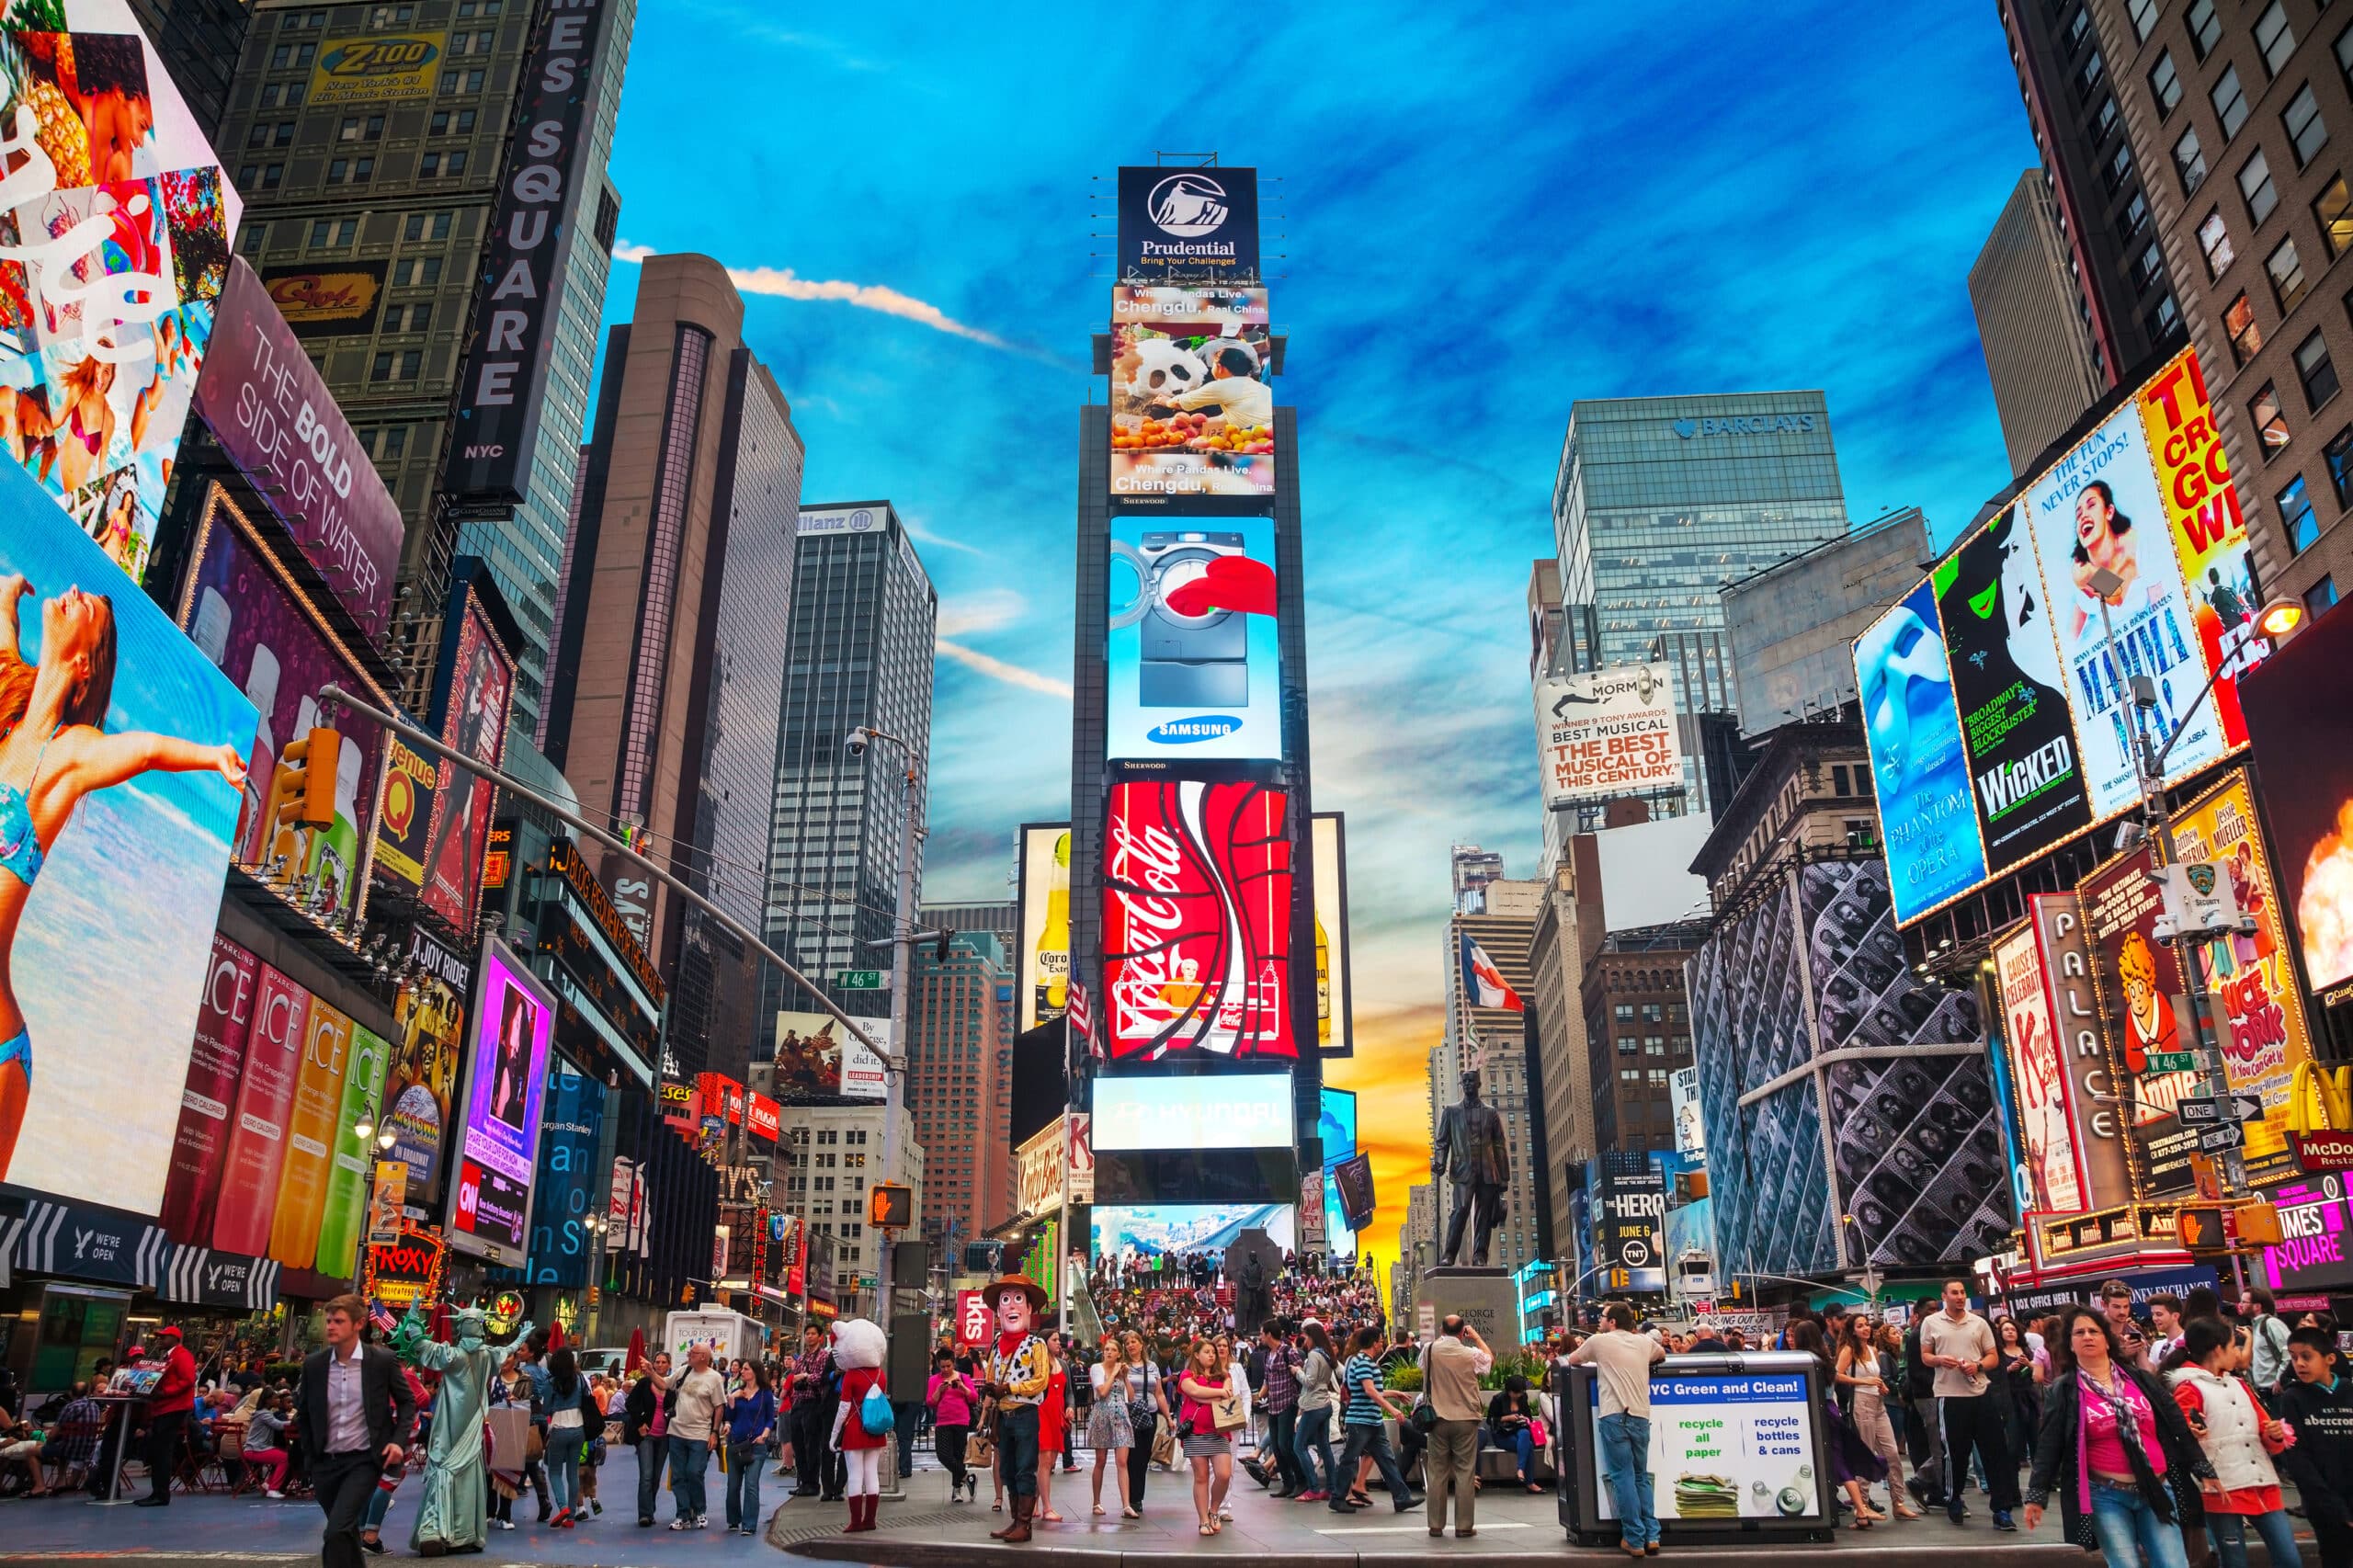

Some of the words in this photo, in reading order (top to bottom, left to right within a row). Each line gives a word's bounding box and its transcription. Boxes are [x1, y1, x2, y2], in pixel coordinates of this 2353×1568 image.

[330, 41, 429, 75] Z100
[313, 91, 334, 102] Hit
[337, 90, 378, 99] Music
[381, 87, 428, 97] Station
[324, 81, 358, 91] New
[1142, 241, 1235, 256] Prudential
[475, 120, 562, 405] SQUARE
[1141, 257, 1165, 266] Bring
[1188, 256, 1236, 266] Challenges
[1219, 290, 1245, 298] Live.
[1116, 301, 1202, 317] Chengdu,
[254, 324, 298, 419] THE
[294, 400, 352, 499] BOLD
[1702, 415, 1813, 436] BARCLAYS
[464, 445, 504, 459] NYC
[2054, 453, 2079, 483] THE
[2080, 429, 2106, 461] FUN
[1135, 464, 1176, 474] Where
[1176, 464, 1221, 474] Pandas
[1224, 464, 1252, 474] Live.
[2041, 474, 2080, 515] NEVER
[2082, 431, 2129, 482] STOPS!
[236, 382, 292, 478] SIDE
[291, 459, 322, 510] OF
[322, 494, 380, 604] WATER
[1116, 476, 1207, 494] Chengdu,
[2075, 607, 2190, 722] MAMMA
[1159, 723, 1232, 736] SAMSUNG
[1552, 719, 1589, 731] WINNER
[1600, 714, 1625, 723] TONY
[1627, 709, 1667, 720] AWARDS
[1971, 706, 2006, 740] BIGGEST
[1552, 729, 1591, 743] BEST
[1597, 719, 1668, 737] MUSICAL
[2188, 728, 2208, 745] ABBA
[1608, 732, 1669, 755] BEST
[1555, 754, 1641, 777] MUSICAL
[1645, 750, 1672, 765] OF
[1556, 775, 1593, 789] THIS
[382, 766, 415, 844] Q
[1913, 790, 1933, 810] The
[1891, 788, 1967, 850] PHANTOM
[2215, 801, 2236, 825] Jessie
[1918, 834, 1927, 855] of
[1929, 829, 1943, 848] the
[2213, 815, 2248, 851] MUELLER
[1908, 844, 1959, 884] OPERA
[2112, 868, 2143, 894] ULTIMATE
[2093, 892, 2126, 919] FEEL-GOOD
[2105, 913, 2112, 923] IS
[2113, 903, 2130, 918] BACK
[2131, 892, 2144, 906] AND
[2098, 923, 2120, 940] BETTER
[2120, 911, 2138, 926] THAN
[214, 935, 255, 967] SPARKLING
[420, 943, 442, 972] JOY
[442, 952, 470, 993] RIDE!
[2007, 951, 2030, 982] CAUSE
[202, 951, 251, 1025] ICE
[267, 971, 304, 1000] SPARKLING
[851, 973, 864, 987] 46
[868, 972, 877, 981] ST
[2221, 968, 2269, 1019] NICE
[258, 985, 301, 1052] ICE
[862, 1022, 874, 1033] By
[2055, 913, 2115, 1139] PALACE
[210, 1037, 242, 1060] Raspberry
[308, 1015, 346, 1076] ICE
[350, 1041, 381, 1098] ICE
[853, 1055, 869, 1065] did
[870, 1054, 881, 1065] it.
[2149, 1056, 2159, 1071] W
[2164, 1056, 2177, 1070] 46
[2180, 1054, 2188, 1062] ST
[2231, 1064, 2236, 1080] If
[2237, 1062, 2251, 1079] You
[2251, 1059, 2264, 1076] Can
[2263, 1053, 2277, 1070] Get
[848, 1072, 882, 1081] LEADERSHIP
[183, 1094, 198, 1105] ZERO
[198, 1097, 224, 1116] CALORIES
[2134, 1071, 2199, 1126] Annie
[1157, 1102, 1278, 1119] HYUNDAI
[2187, 1106, 2211, 1117] ONE
[244, 1117, 256, 1128] ZERO
[256, 1122, 279, 1137] CALORIES
[392, 1109, 439, 1140] MOTOWN
[565, 1122, 591, 1136] Stanley
[2206, 1135, 2218, 1147] ONE
[2224, 1130, 2237, 1141] WAY
[2303, 1141, 2353, 1155] McDo
[403, 1147, 430, 1168] BROADWAY
[1018, 1151, 1042, 1215] Kinky
[1041, 1141, 1064, 1199] Boots
[460, 1181, 478, 1215] CNN
[1606, 1199, 1616, 1208] THE
[1616, 1193, 1665, 1218] HERO
[1619, 1225, 1643, 1238] JUNE
[1643, 1225, 1651, 1237] 6
[2080, 1225, 2101, 1243] Annie
[2111, 1219, 2133, 1236] Annie
[96, 1233, 120, 1247] WE'RE
[93, 1248, 114, 1261] OPEN
[376, 1245, 435, 1276] ROXY
[1626, 1249, 1645, 1258] TNT
[2277, 1233, 2346, 1271] SQUARE
[223, 1265, 246, 1278] WE'RE
[222, 1279, 241, 1292] OPEN
[2016, 1298, 2029, 1310] BOX
[2030, 1294, 2052, 1308] OFFICE
[2052, 1291, 2070, 1305] HERE
[966, 1295, 987, 1340] tkts
[1458, 1309, 1495, 1317] GEORGE
[1737, 1315, 1755, 1324] OUT
[1756, 1314, 1769, 1323] OF
[1674, 1383, 1717, 1395] Green
[1722, 1382, 1748, 1393] and
[1753, 1381, 1799, 1393] Clean!
[1679, 1418, 1723, 1429] recycle
[1755, 1416, 1799, 1428] recycle
[1695, 1433, 1710, 1443] all
[1756, 1431, 1800, 1440] bottles
[1686, 1448, 1722, 1459] paper
[1758, 1446, 1768, 1455] &
[1771, 1446, 1801, 1455] cans
